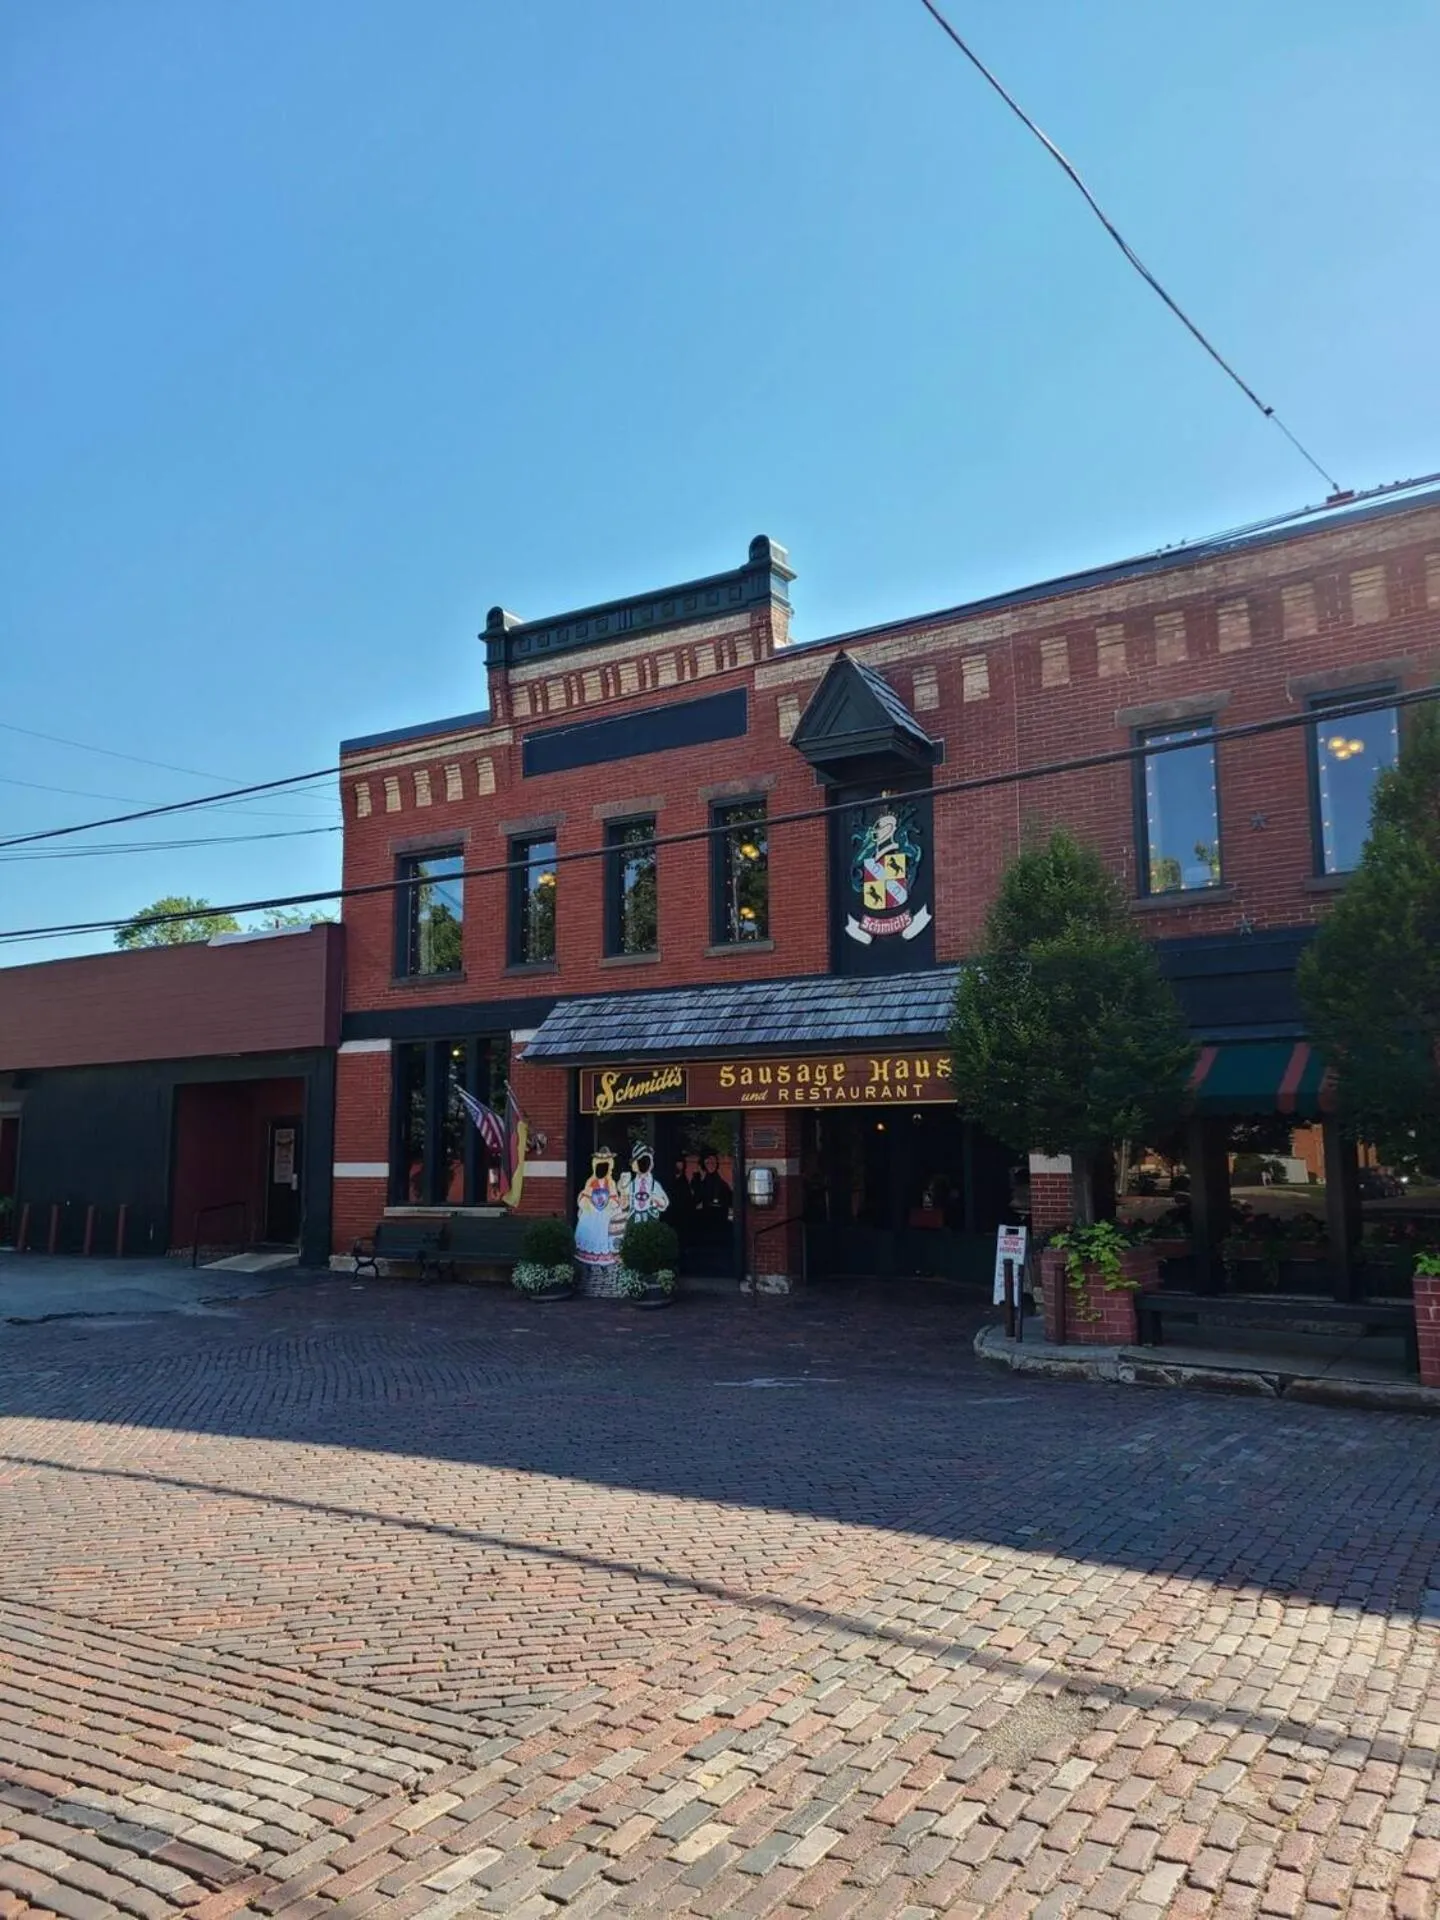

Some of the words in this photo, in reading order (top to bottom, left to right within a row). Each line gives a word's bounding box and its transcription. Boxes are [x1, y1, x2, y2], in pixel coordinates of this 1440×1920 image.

[720, 1062, 846, 1087] Sausage
[869, 1058, 952, 1082] Haus
[596, 1066, 683, 1116] Schmidt's
[741, 1090, 769, 1102] und
[778, 1084, 923, 1101] RESTAURANT
